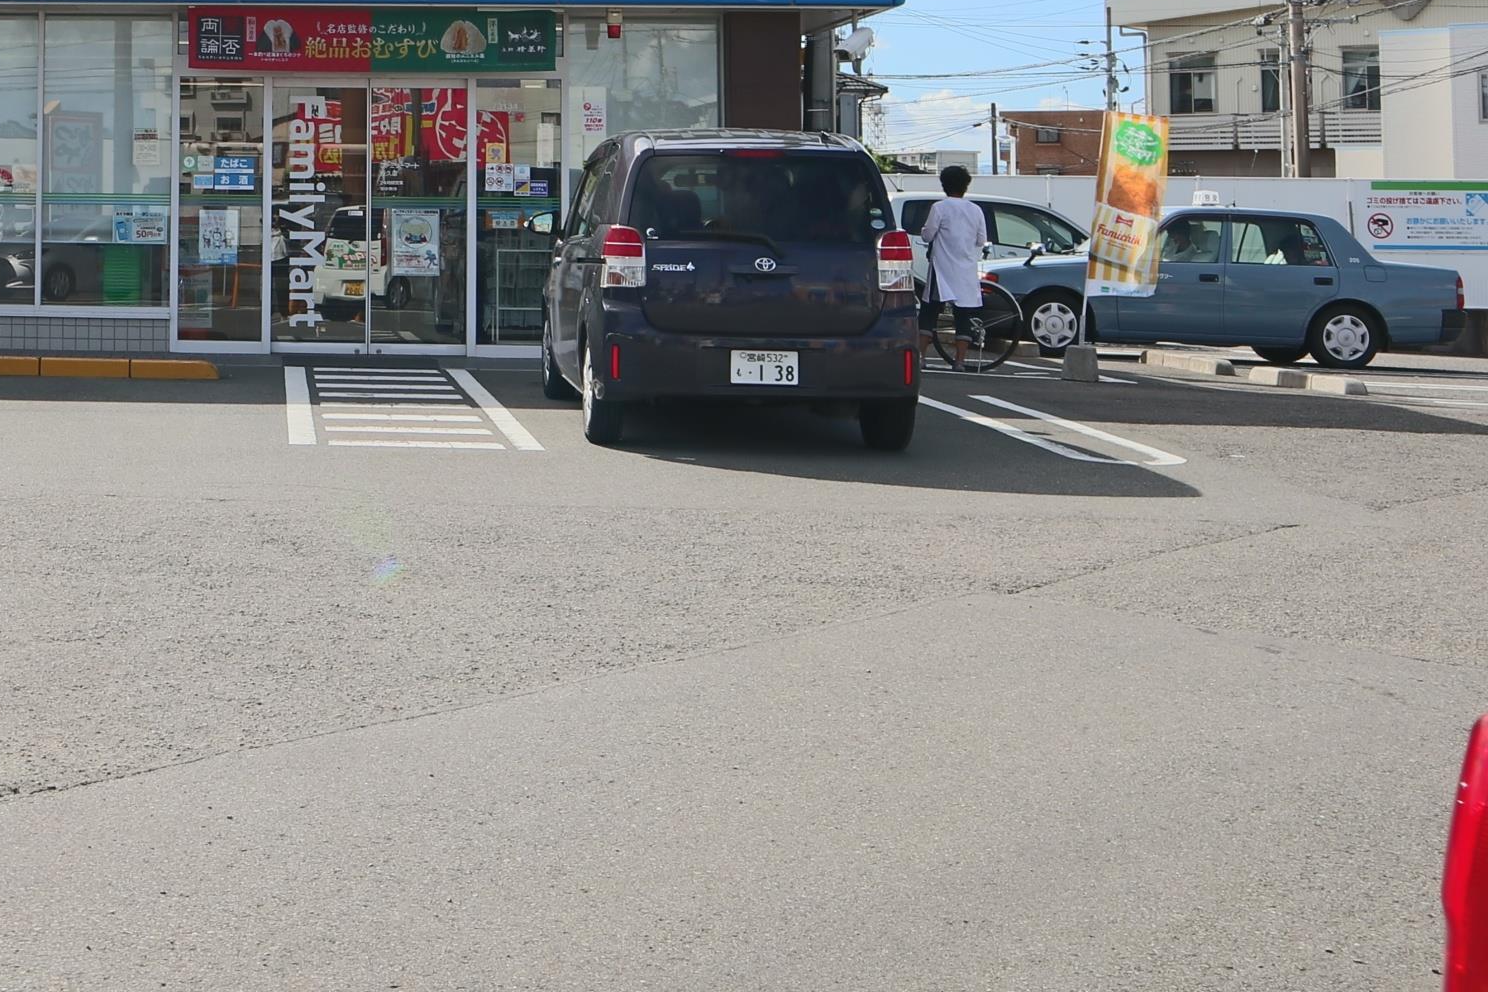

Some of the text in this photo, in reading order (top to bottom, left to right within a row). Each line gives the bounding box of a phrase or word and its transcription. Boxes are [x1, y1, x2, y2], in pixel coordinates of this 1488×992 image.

[327, 23, 416, 35] 名店監修のこだわり
[304, 37, 438, 59] 絶品おむすび
[220, 158, 249, 168] たばこ
[220, 175, 249, 185] お酒
[279, 96, 326, 328] FamilyMart
[651, 263, 687, 272] SPADE
[746, 353, 784, 363] 宮崎 532
